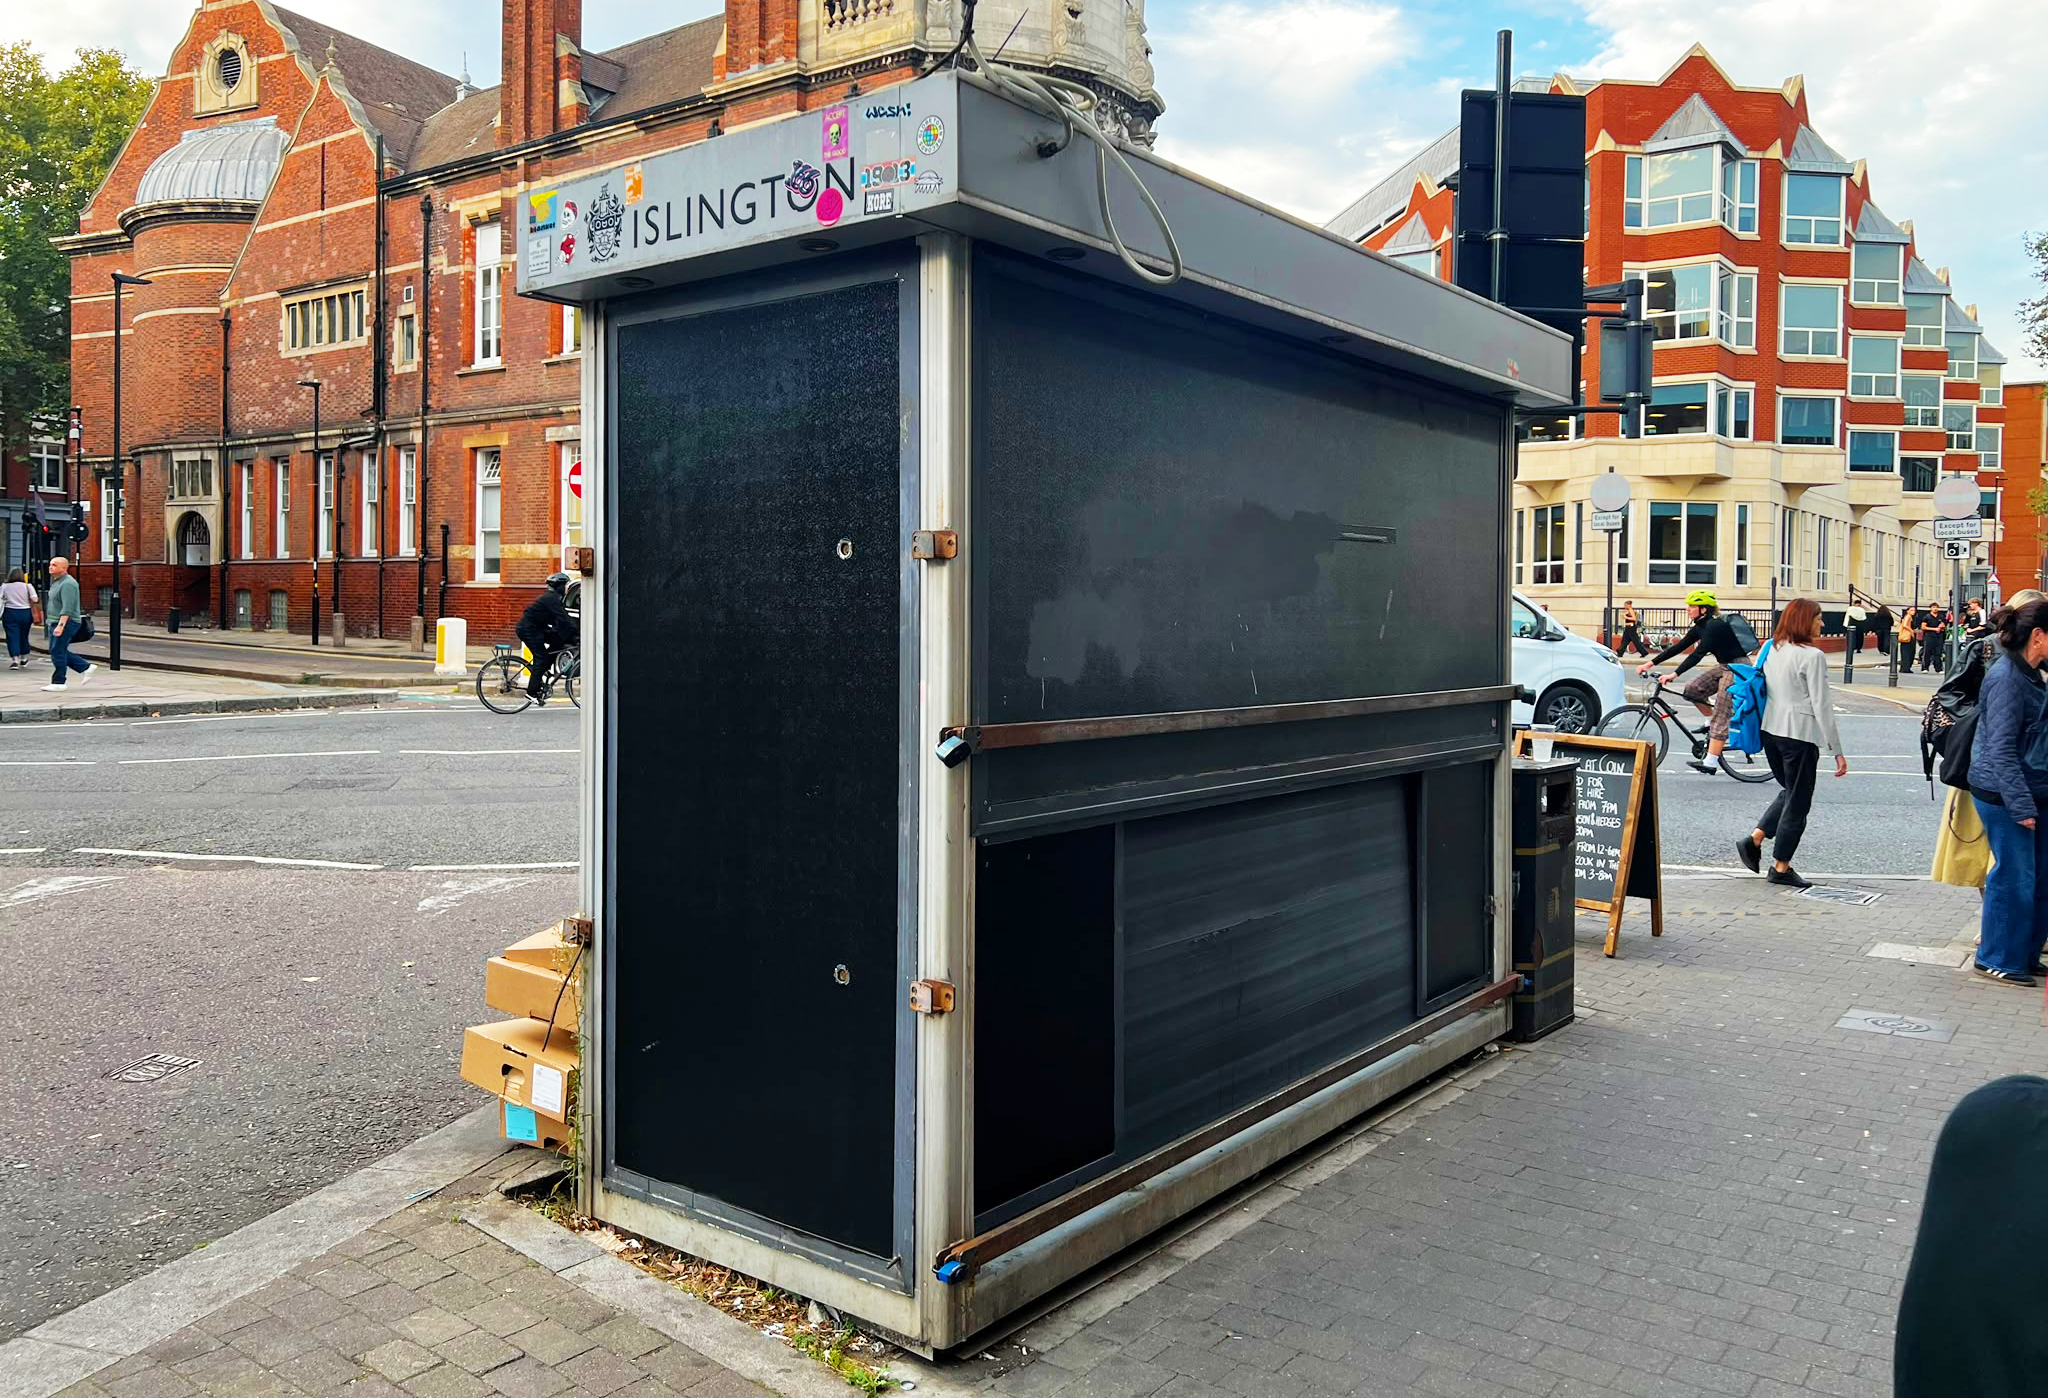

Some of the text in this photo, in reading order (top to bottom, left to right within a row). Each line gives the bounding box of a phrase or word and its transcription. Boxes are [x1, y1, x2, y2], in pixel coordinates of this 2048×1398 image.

[919, 138, 942, 153] RECORDS
[832, 148, 847, 157] GOOD
[633, 157, 855, 248] ISLINGTON
[866, 192, 892, 212] KORE
[1585, 759, 1597, 772] AT
[1599, 754, 1625, 774] COIN
[1587, 776, 1603, 788] FOR
[1587, 787, 1605, 799] HIRE
[1578, 799, 1618, 815] FROM 7PM
[1577, 841, 1595, 854] FROM
[1596, 858, 1606, 868] IN
[1608, 859, 1620, 871] THE
[1588, 869, 1613, 882] 3-8PM
